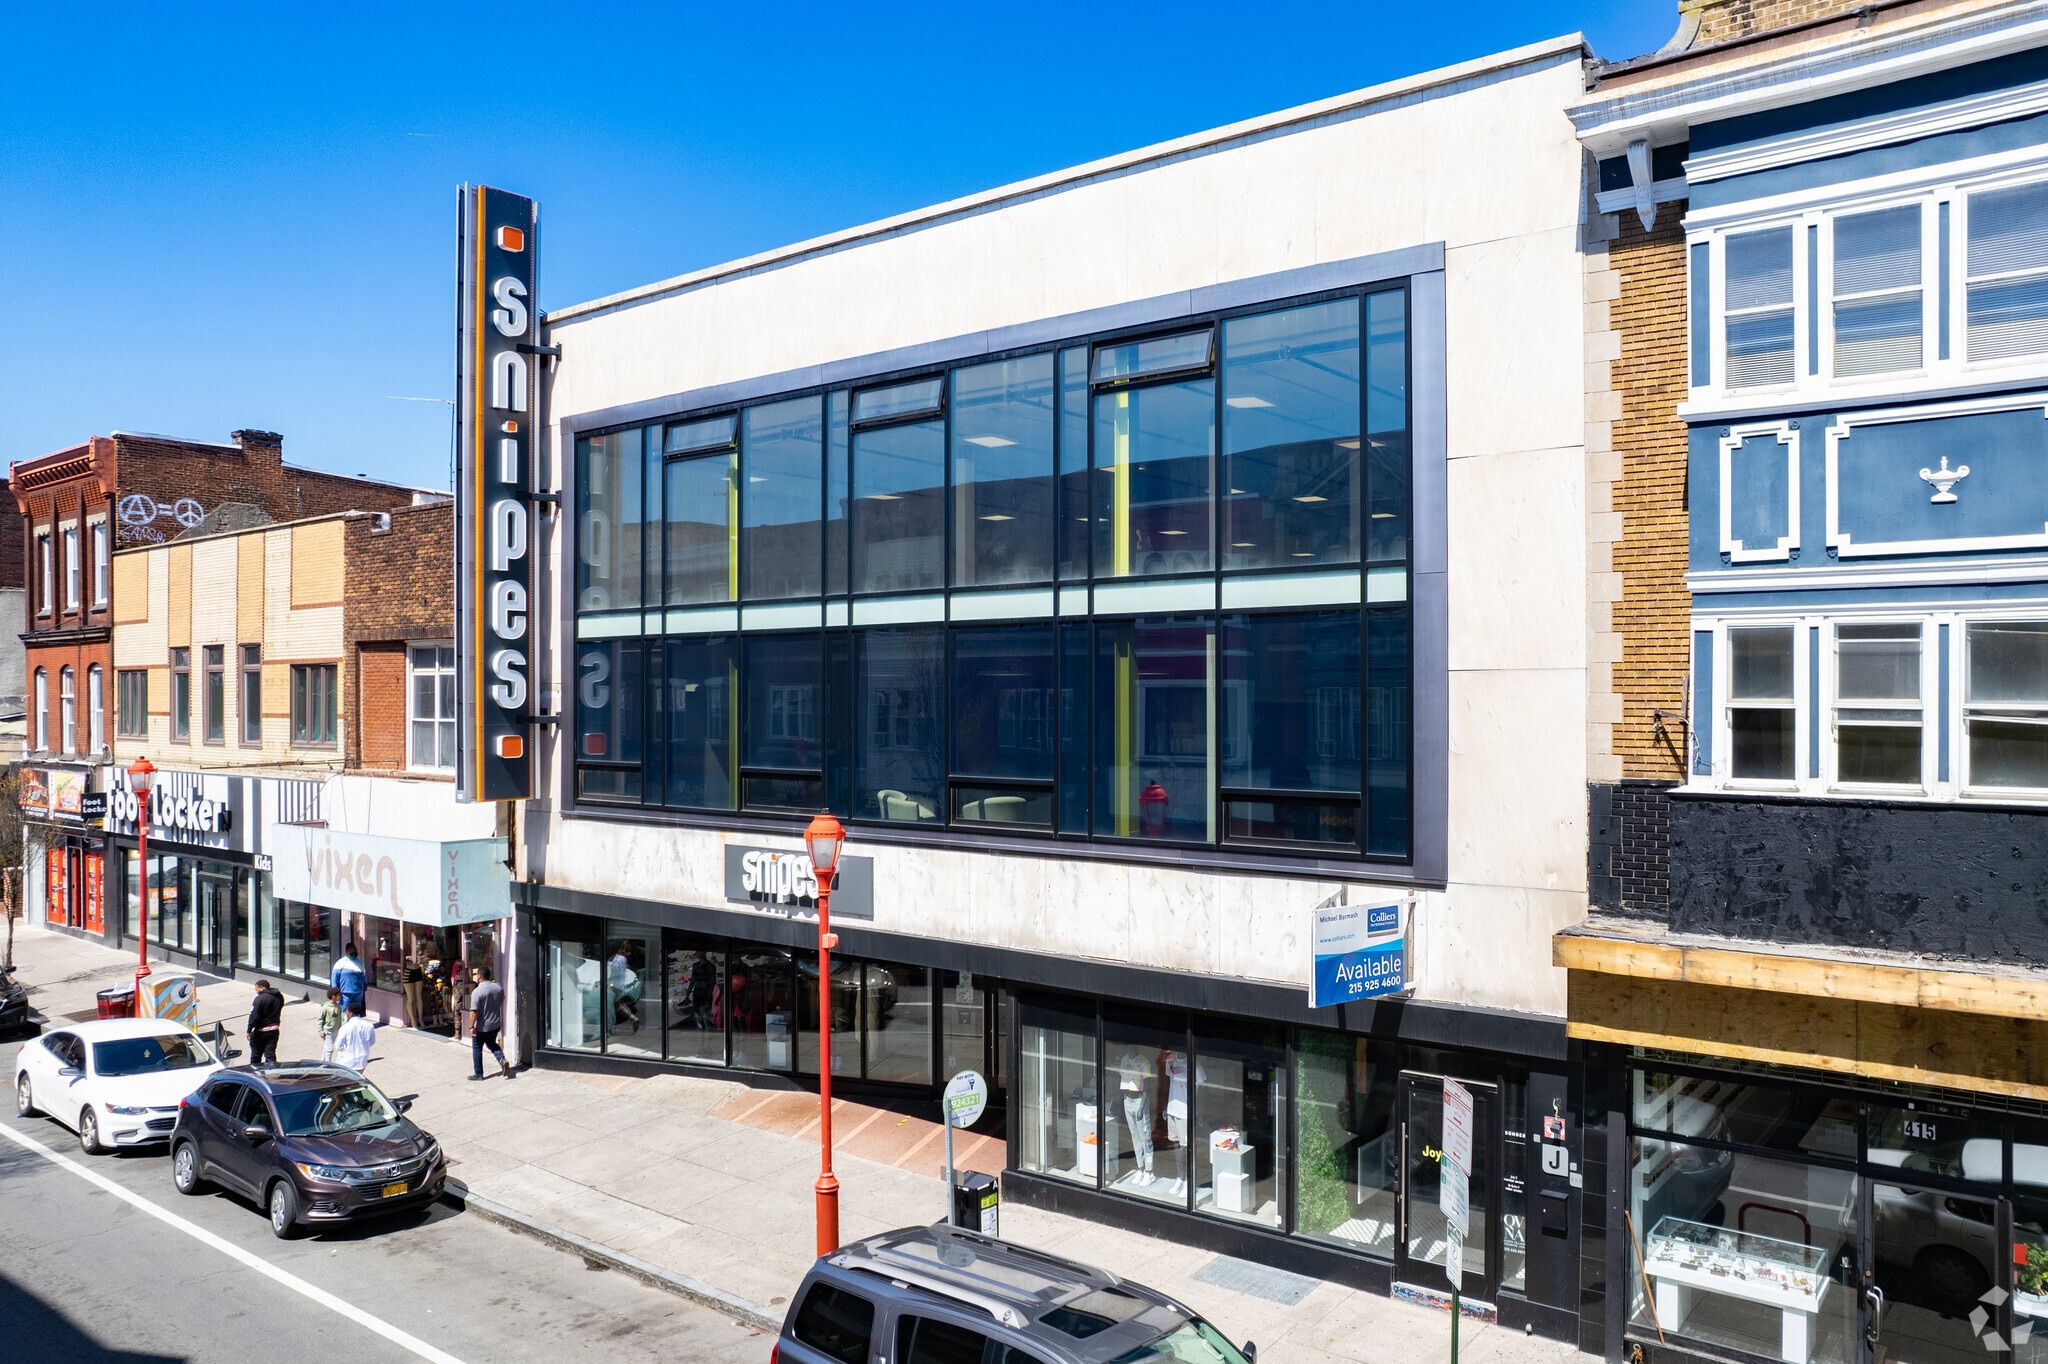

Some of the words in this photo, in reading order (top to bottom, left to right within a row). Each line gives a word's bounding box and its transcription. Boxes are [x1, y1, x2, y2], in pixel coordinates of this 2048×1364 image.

[490, 275, 529, 711] snipes
[82, 798, 102, 806] Foot
[82, 806, 107, 814] Locke
[107, 780, 140, 822] Foo
[152, 785, 225, 833] Locker
[254, 855, 272, 871] Kids
[307, 834, 404, 918] vixen
[447, 850, 462, 919] vixen
[742, 850, 821, 904] snipes
[1319, 914, 1338, 924] Michael
[1370, 911, 1396, 923] Colliers
[1319, 934, 1355, 944] www.colliers.com
[1335, 954, 1402, 984] Available
[1348, 981, 1363, 994] 215
[1364, 978, 1379, 991] 925
[1381, 975, 1401, 988] 4600
[951, 1094, 979, 1109] 924321
[1904, 1121, 1936, 1139] 415
[1422, 1145, 1442, 1163] Joy
[1548, 1150, 1560, 1169] J
